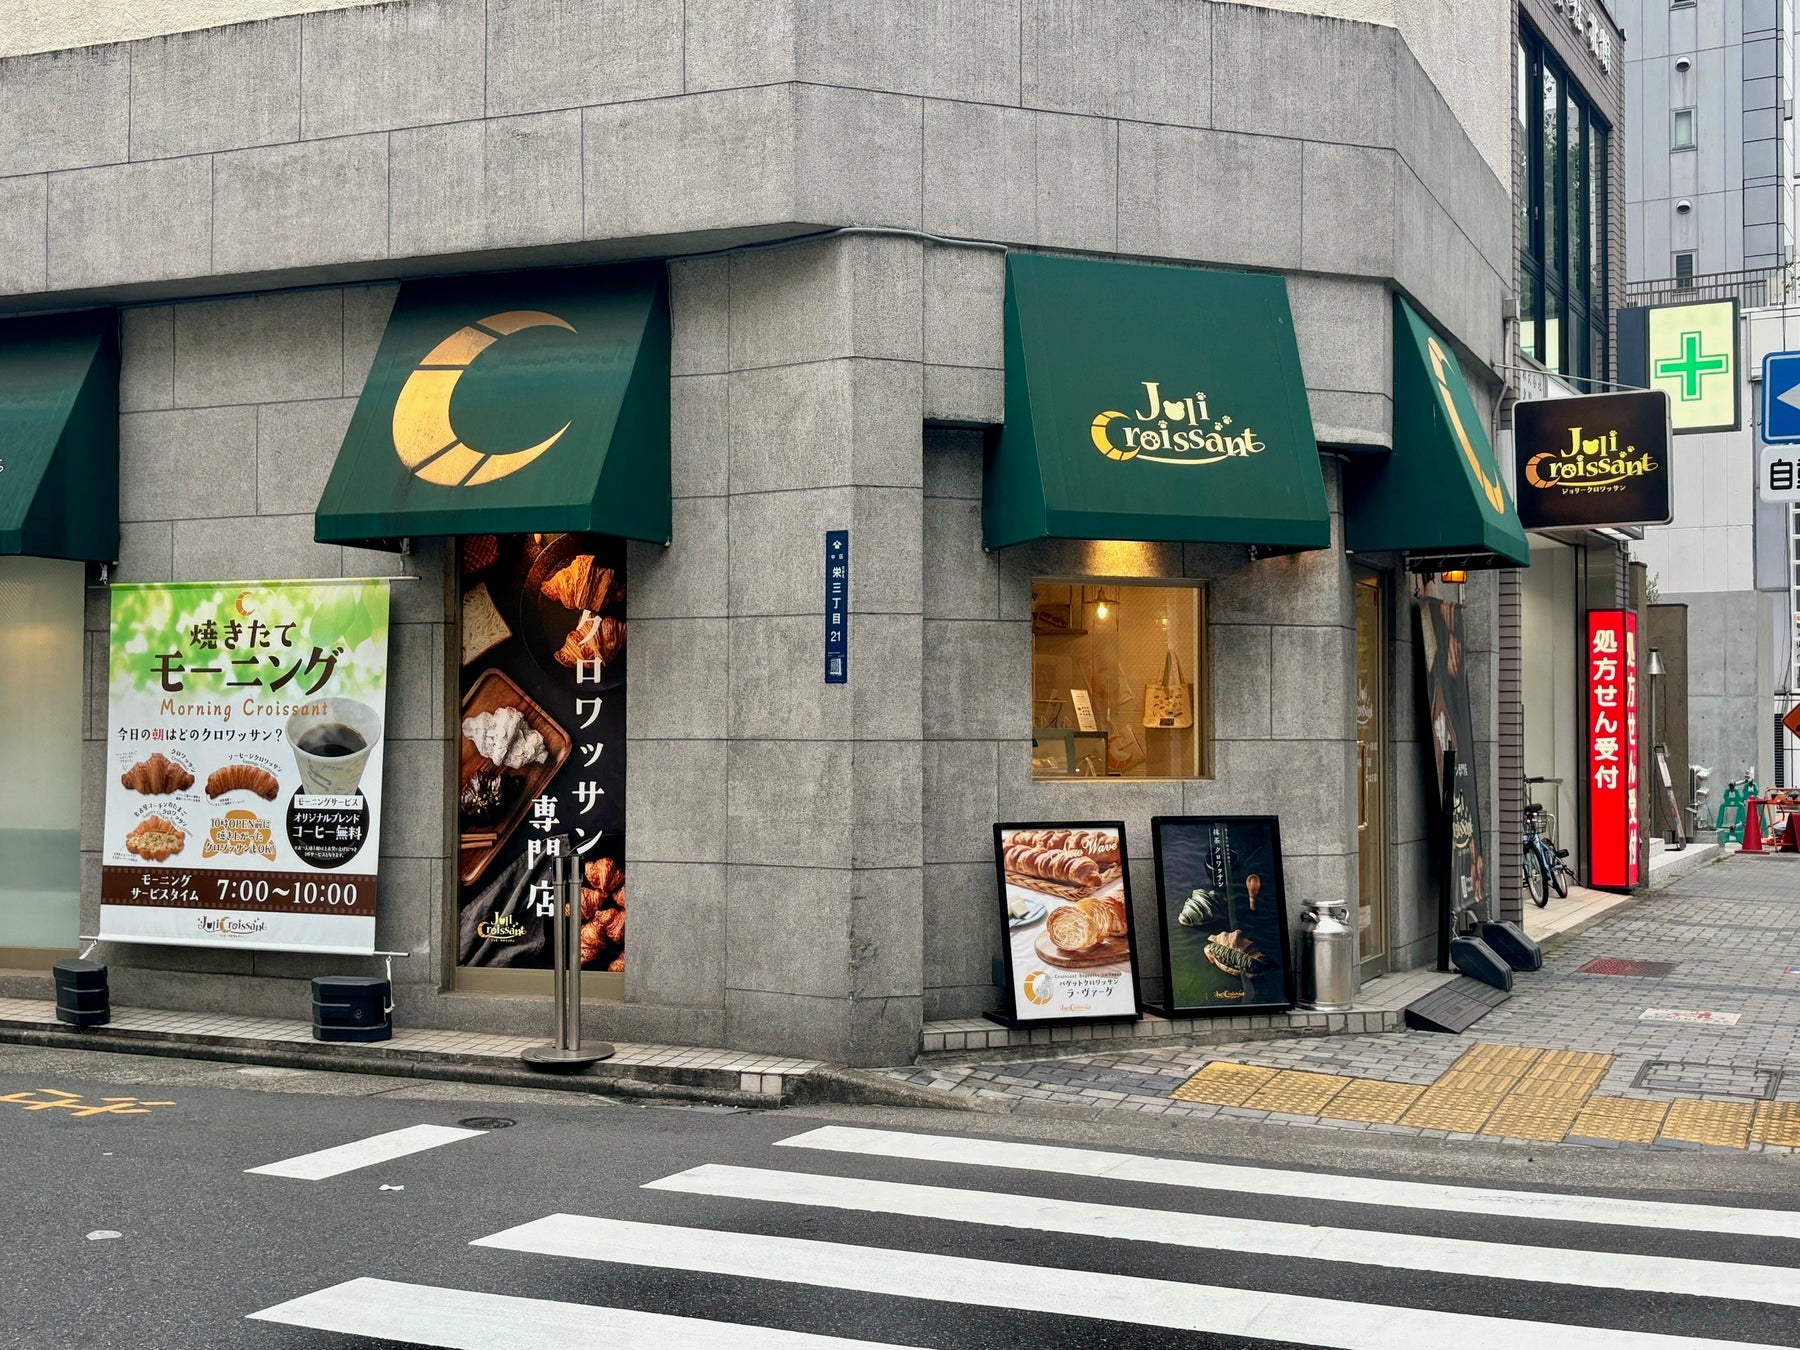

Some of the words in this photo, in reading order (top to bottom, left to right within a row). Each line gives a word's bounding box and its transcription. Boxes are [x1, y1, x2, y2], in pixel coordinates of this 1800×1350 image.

[1135, 381, 1210, 426] Joli
[1090, 410, 1266, 461] Croissant
[1560, 427, 1618, 458] Joli
[1525, 452, 1659, 489] Croissant
[1770, 458, 1800, 491] 自
[1562, 485, 1626, 495] ジョリークロワッサン
[190, 619, 297, 650] 焼きたて
[830, 631, 841, 642] 21
[150, 646, 344, 696] モーニング
[160, 699, 232, 722] Morning
[242, 698, 328, 717] Croissant
[1592, 629, 1619, 790] 処方せん受付
[117, 728, 282, 742] 今日の朝はどのクロワッサン？
[572, 609, 605, 855] クロワッサン
[1626, 631, 1637, 866] 処方せん受付
[298, 797, 359, 807] モーニングサービス
[292, 824, 362, 841] コーヒー無料
[293, 812, 360, 824] オリジナルブレンド
[526, 795, 561, 917] 専門店
[130, 887, 199, 901] サービスタイム
[141, 874, 191, 887] モーニング
[217, 878, 358, 906] 7:00〜10:00
[477, 921, 528, 939] Croissant
